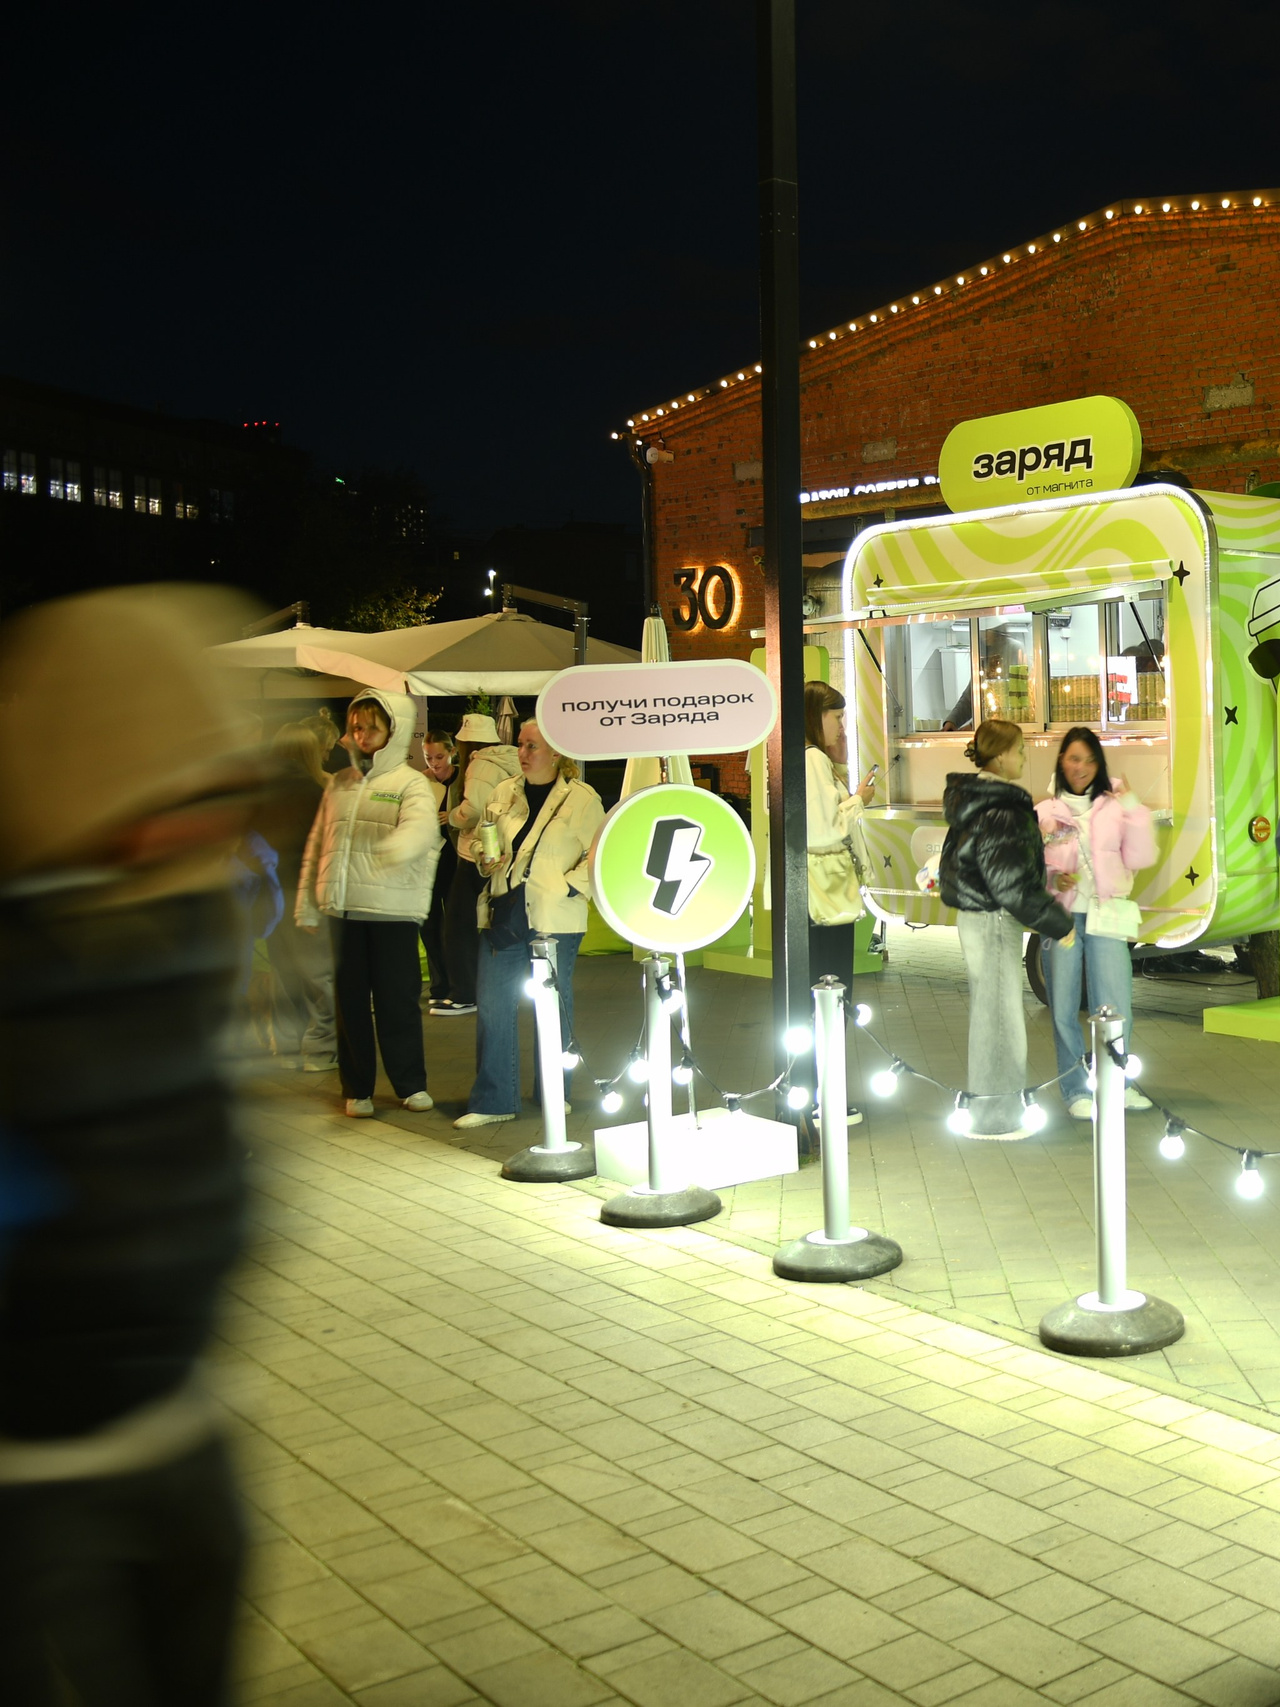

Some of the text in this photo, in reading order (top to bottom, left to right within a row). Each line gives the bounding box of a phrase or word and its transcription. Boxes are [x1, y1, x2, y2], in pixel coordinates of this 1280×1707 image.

[972, 438, 1093, 481] заряд
[1026, 478, 1093, 496] от магнита
[672, 565, 734, 631] 30
[562, 693, 754, 712] получи подарок
[600, 711, 719, 727] от Заряда
